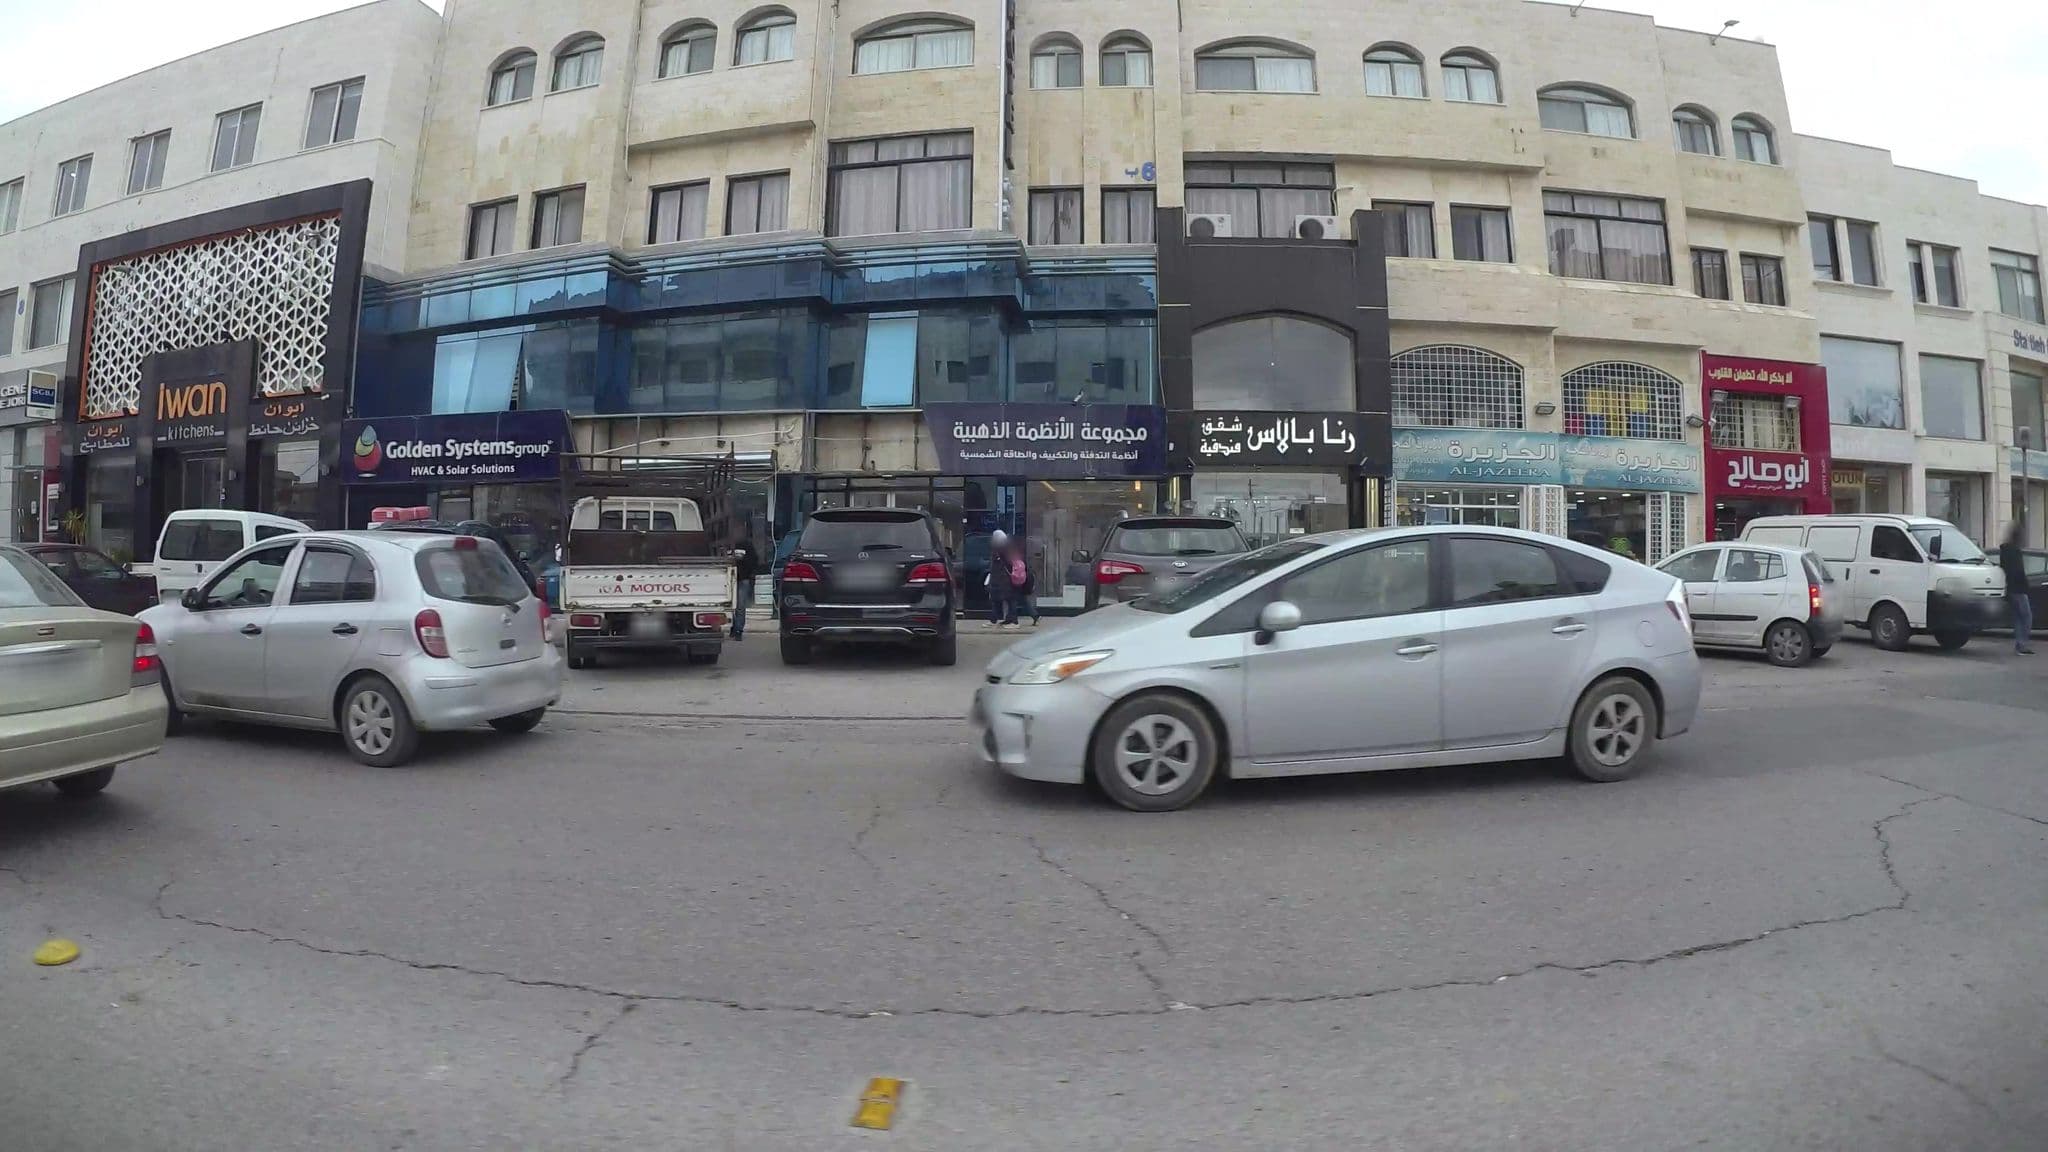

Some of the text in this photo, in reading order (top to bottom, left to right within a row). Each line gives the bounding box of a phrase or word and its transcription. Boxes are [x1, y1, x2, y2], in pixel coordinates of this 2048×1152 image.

[953, 416, 1147, 444] مجموعة الأنظمة الذهبية
[1201, 416, 1243, 436] شقق
[1247, 416, 1356, 454] رنا بالاس
[386, 440, 442, 459] Golden
[960, 449, 1001, 459] الشمسية
[1003, 449, 1037, 460] والطاقة
[1039, 450, 1079, 461] والتكييف
[1111, 449, 1138, 460] أنظمة
[1200, 438, 1241, 456] فندقية
[1448, 440, 1556, 464] الجزيرة
[411, 463, 515, 476] HVAC & Solar Solutions
[1616, 448, 1697, 474] الجزيرة
[1727, 455, 1782, 488] صالح
[630, 583, 690, 593] MOTORS
